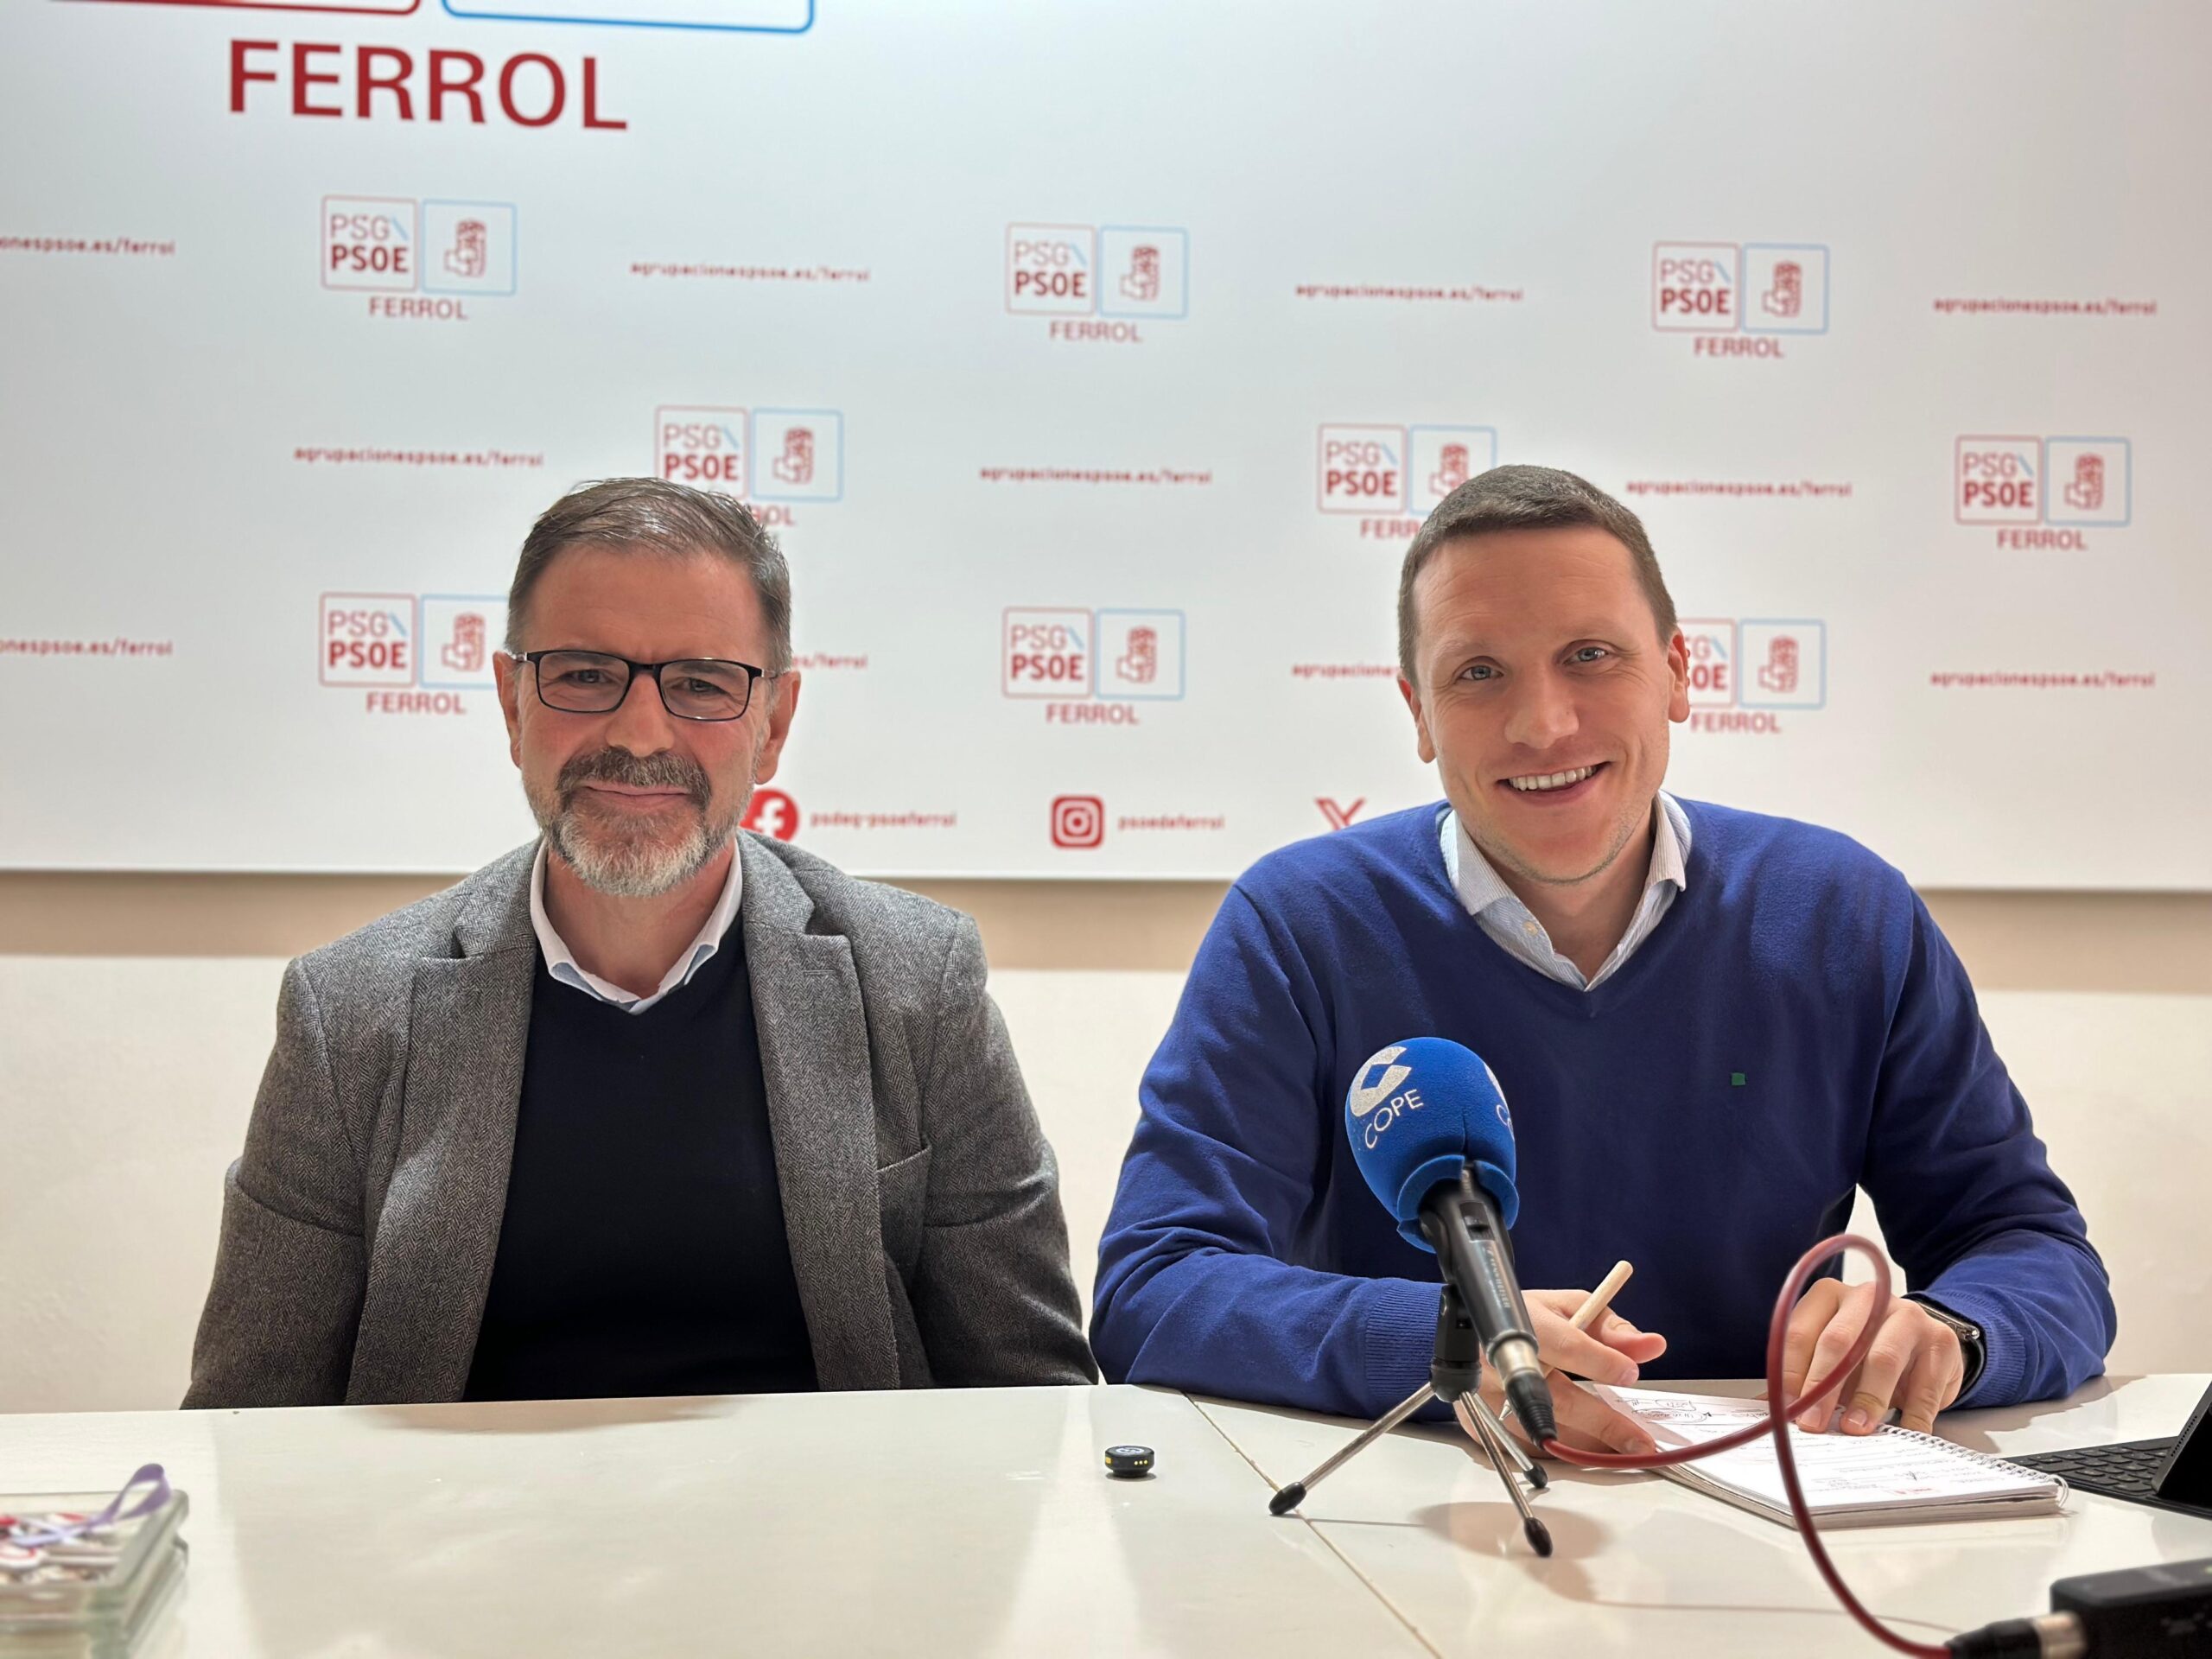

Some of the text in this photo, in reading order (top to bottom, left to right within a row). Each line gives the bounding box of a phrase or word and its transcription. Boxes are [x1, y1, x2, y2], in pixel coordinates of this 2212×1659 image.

[229, 38, 628, 130] FERROL
[330, 244, 409, 274] PSOE
[1014, 270, 1087, 298] PSOE
[368, 296, 467, 320] FERROL
[1660, 287, 1730, 315] PSOE
[1048, 320, 1143, 343] FERROL
[1693, 336, 1784, 359] FERROL
[664, 453, 738, 481] PSOE
[1325, 469, 1397, 497] PSOE
[1962, 481, 2034, 509] PSOE
[1360, 518, 1420, 539] FERR
[1996, 529, 2088, 550] FERROL
[327, 641, 408, 671] PSOE
[1010, 654, 1084, 681] PSOE
[366, 692, 467, 715] FERROL
[1046, 702, 1140, 726] FERROL
[1690, 712, 1782, 734] FERROL
[1365, 1089, 1424, 1149] COPE
